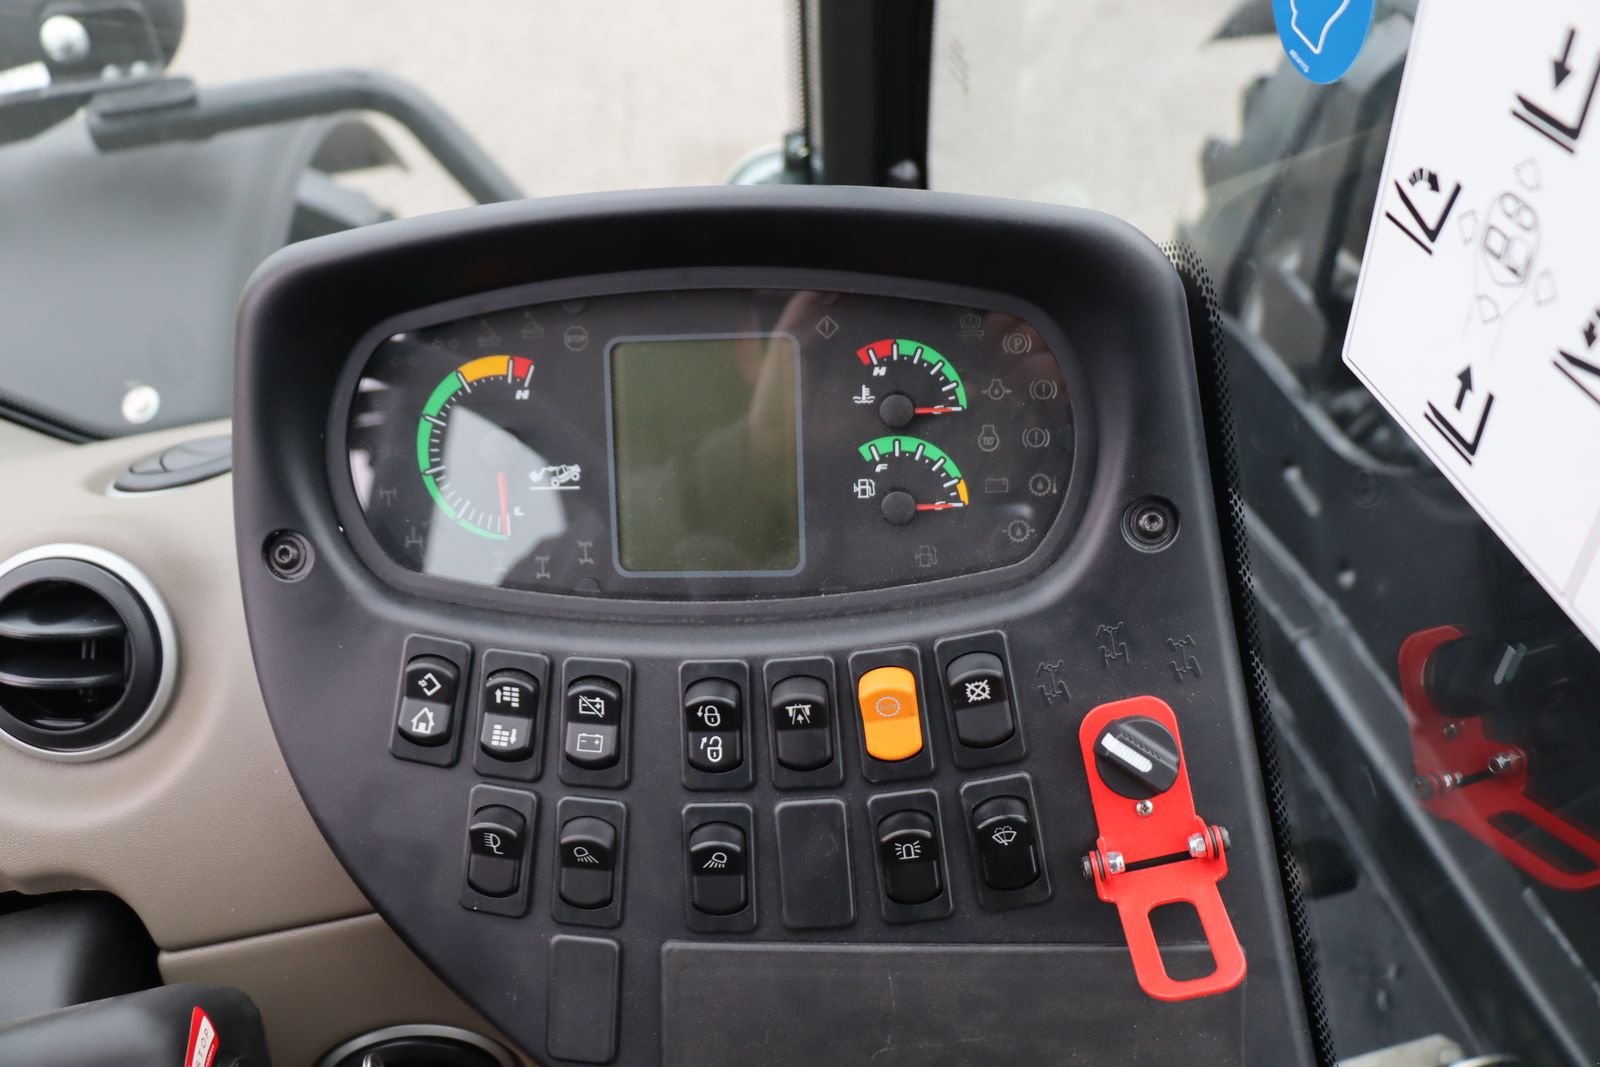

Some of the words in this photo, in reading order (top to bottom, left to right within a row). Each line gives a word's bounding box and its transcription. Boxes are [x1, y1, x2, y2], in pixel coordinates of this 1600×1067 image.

[873, 366, 887, 376] H
[515, 389, 530, 400] H
[875, 463, 888, 473] F
